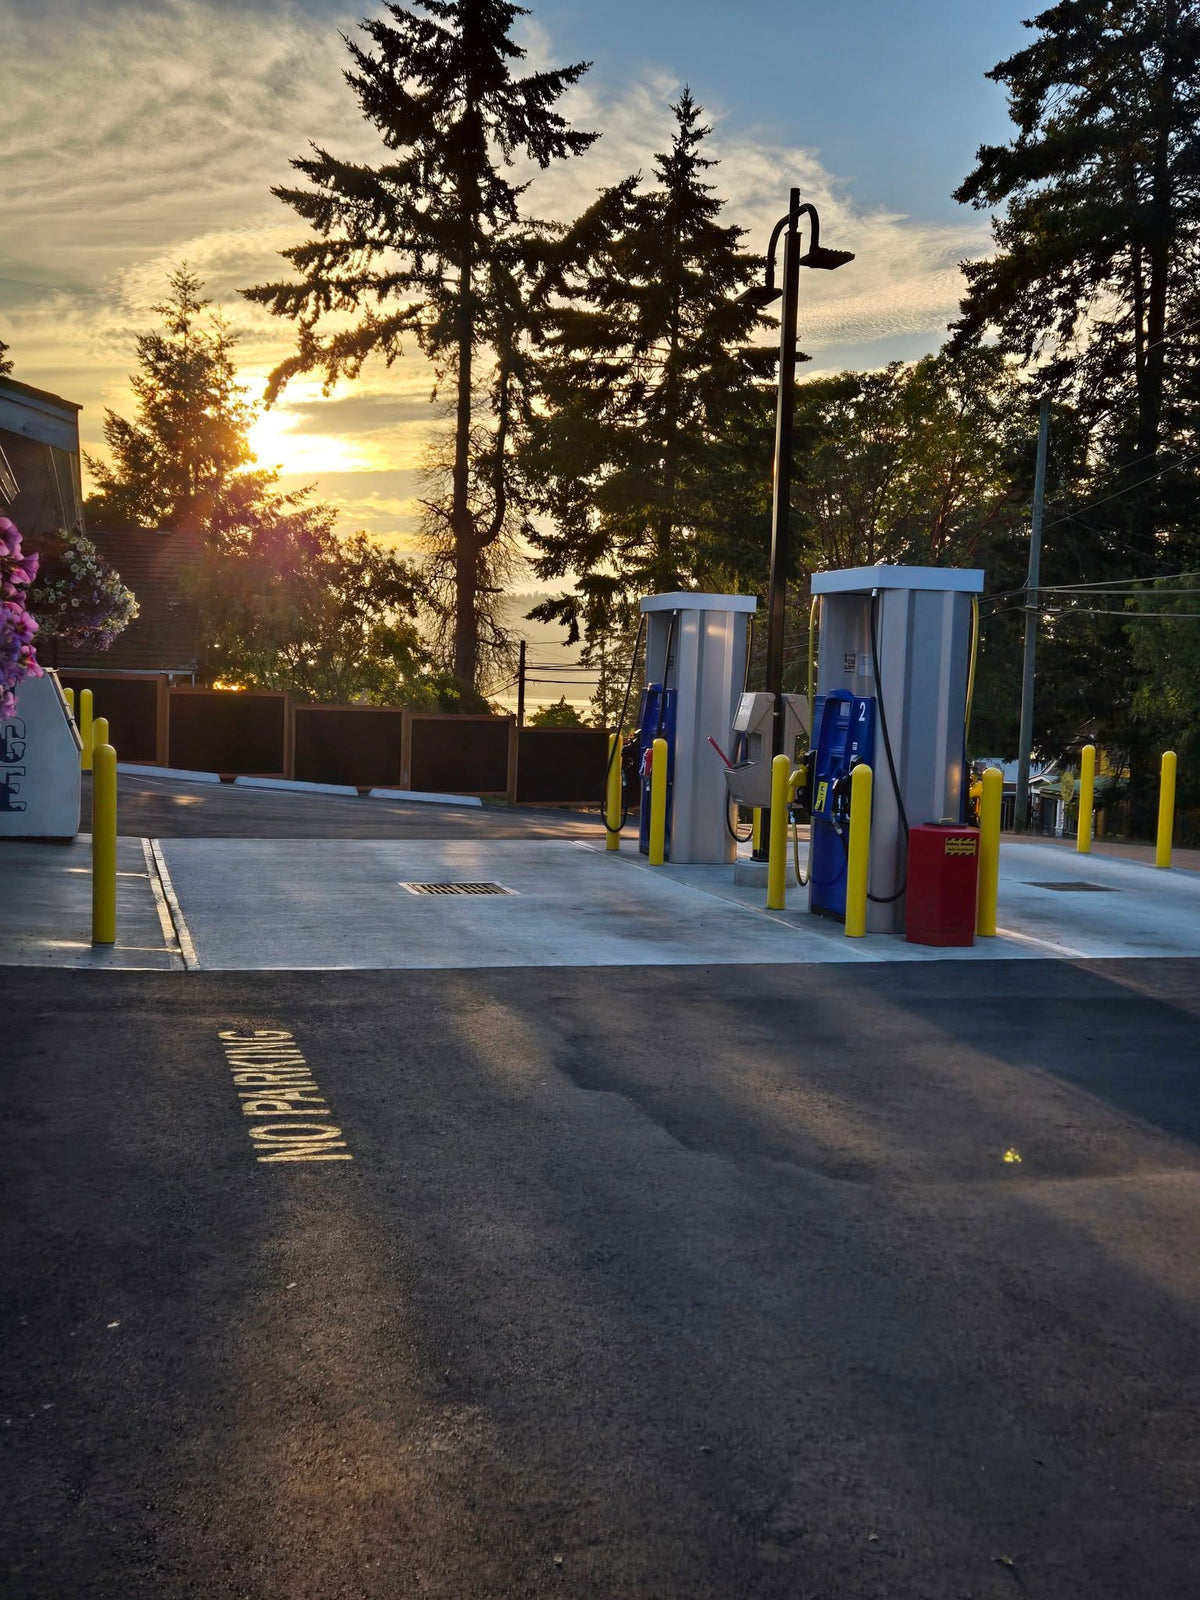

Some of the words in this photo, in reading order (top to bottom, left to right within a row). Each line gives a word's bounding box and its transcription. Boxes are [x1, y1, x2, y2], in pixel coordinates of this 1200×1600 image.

[858, 701, 866, 722] 2
[217, 1030, 331, 1116] PARKING
[248, 1123, 354, 1162] NO
